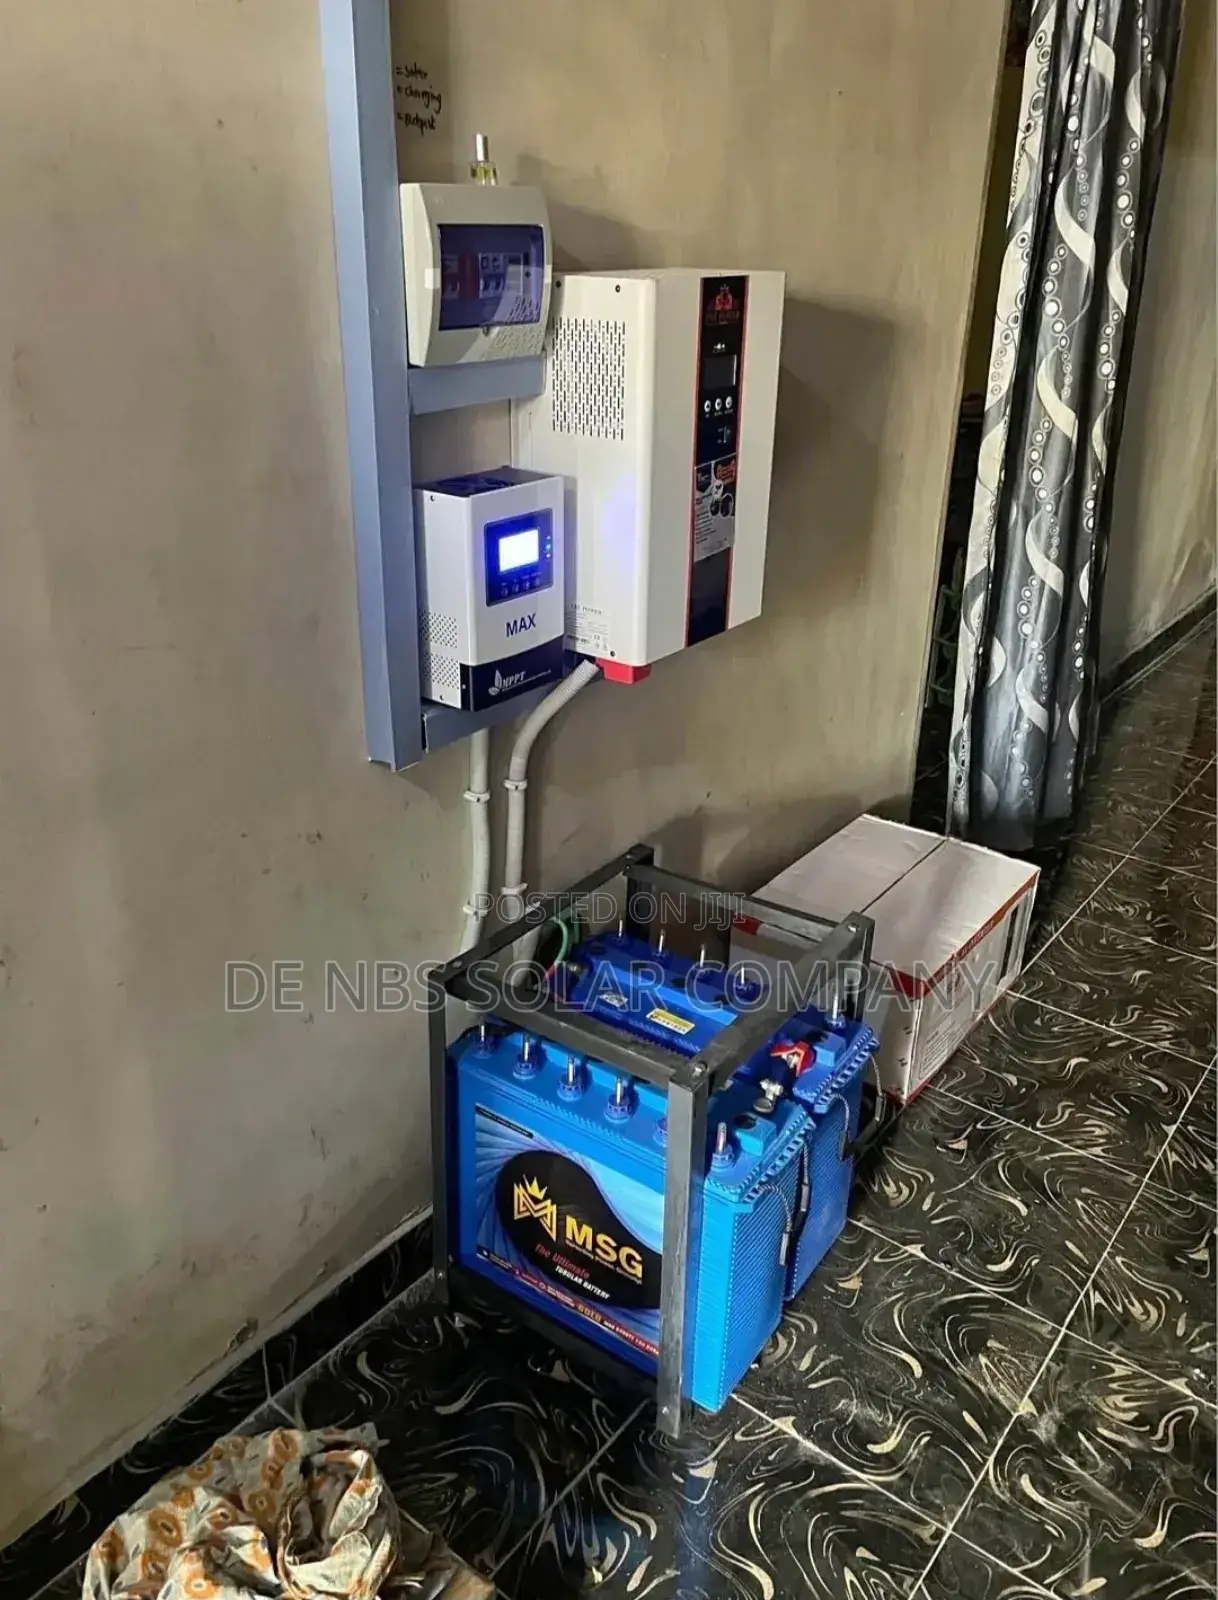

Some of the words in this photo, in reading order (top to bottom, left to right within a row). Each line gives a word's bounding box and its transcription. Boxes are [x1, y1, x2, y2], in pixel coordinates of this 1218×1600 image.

[506, 613, 536, 638] MAX
[565, 1215, 643, 1278] MSG
[555, 1265, 584, 1285] TUBULAR
[583, 1280, 611, 1299] BATTERY
